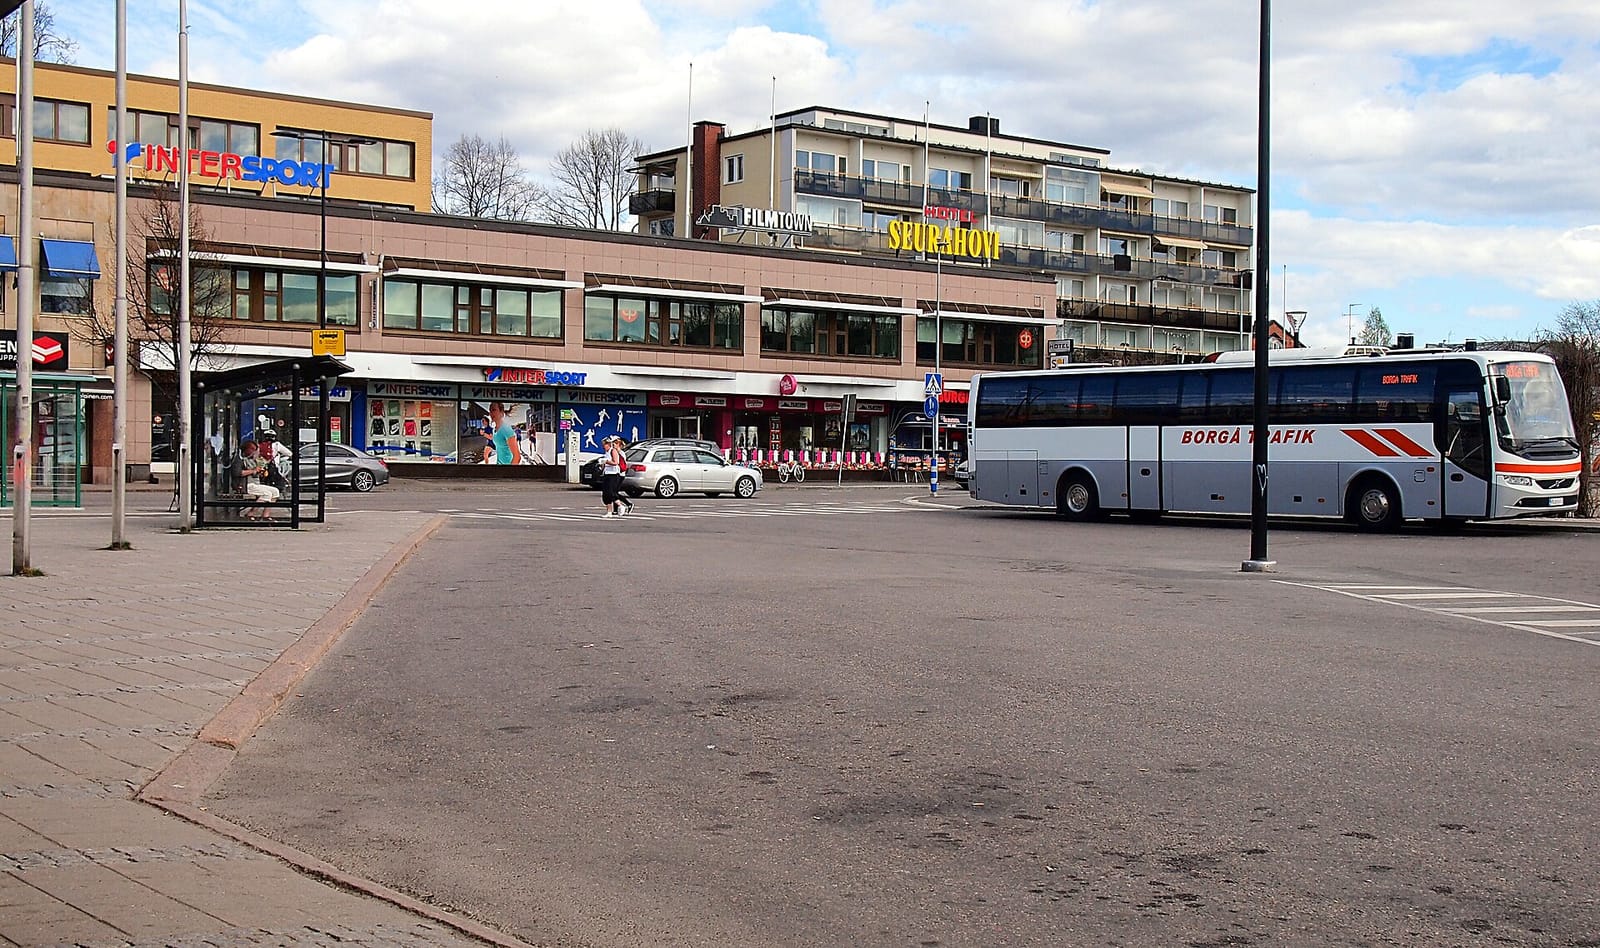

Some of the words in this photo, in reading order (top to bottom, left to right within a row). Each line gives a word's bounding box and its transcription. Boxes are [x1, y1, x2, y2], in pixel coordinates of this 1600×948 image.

[145, 143, 335, 189] INTERSPORT
[743, 207, 813, 232] FILMTOWN
[925, 204, 978, 223] HOTEL
[888, 219, 1000, 260] SEURAHOVI
[500, 367, 587, 386] INTERSPORT
[386, 383, 451, 397] INTERSPORT
[483, 387, 545, 400] INTERSPORT
[579, 391, 637, 404] INTERSPORT
[1181, 426, 1240, 444] BORGÅ
